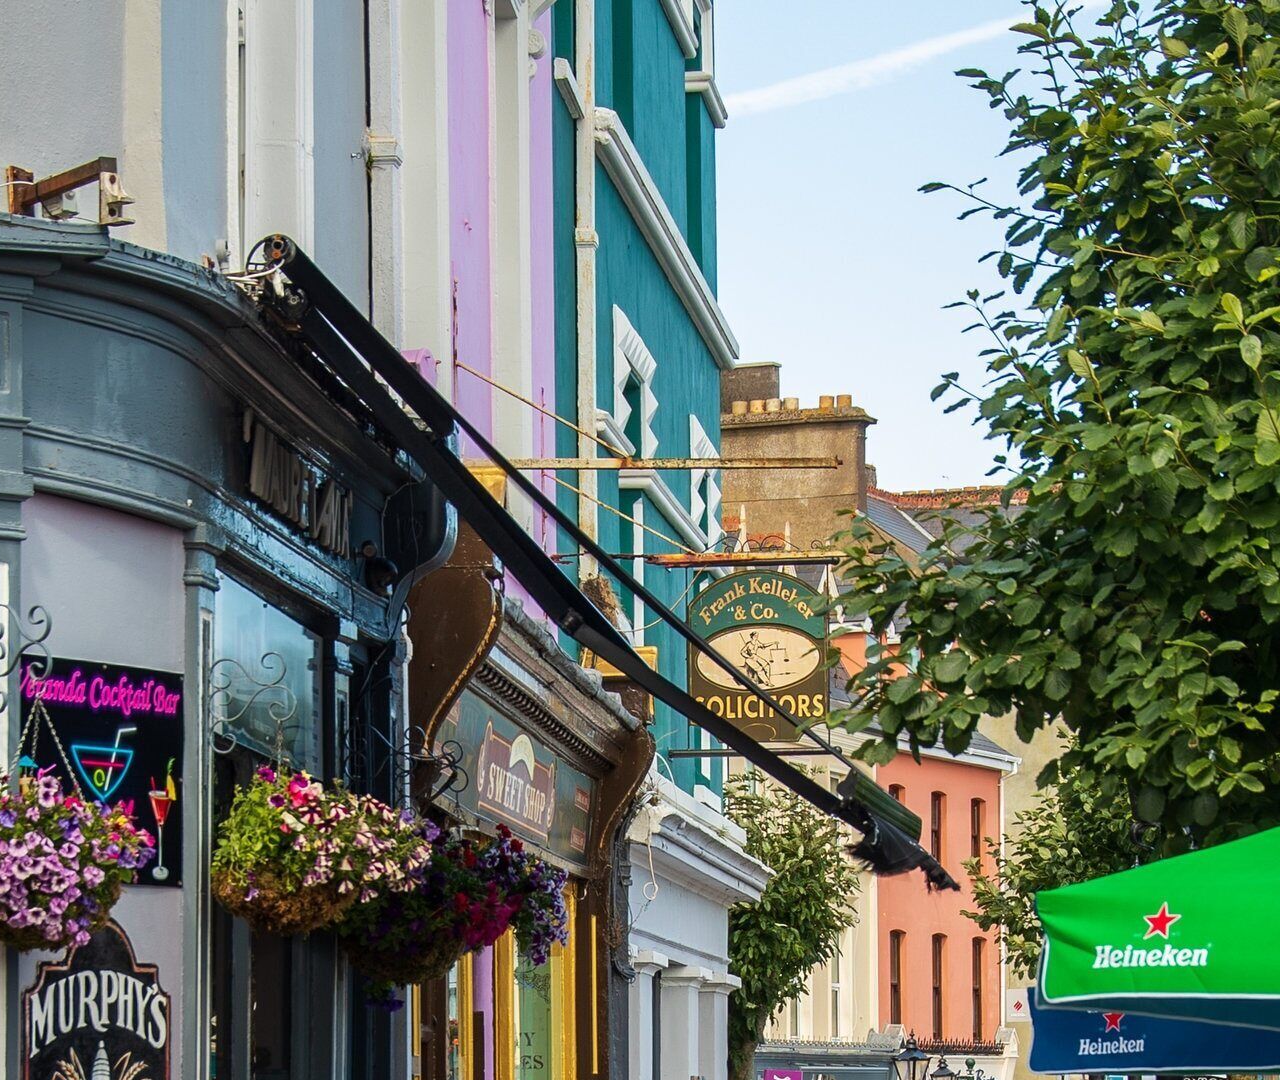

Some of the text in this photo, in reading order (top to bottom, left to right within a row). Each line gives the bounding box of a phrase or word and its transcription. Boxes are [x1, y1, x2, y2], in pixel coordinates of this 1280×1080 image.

[699, 582, 745, 625] Frank
[734, 603, 779, 620] & Co.
[90, 676, 155, 716] Cocktail
[154, 685, 181, 714] Bar
[487, 763, 525, 813] SWEET
[523, 783, 547, 825] SHOP
[1092, 944, 1209, 969] Heineken
[30, 970, 167, 1058] MURPHY'S
[1078, 1036, 1145, 1056] Heineken
